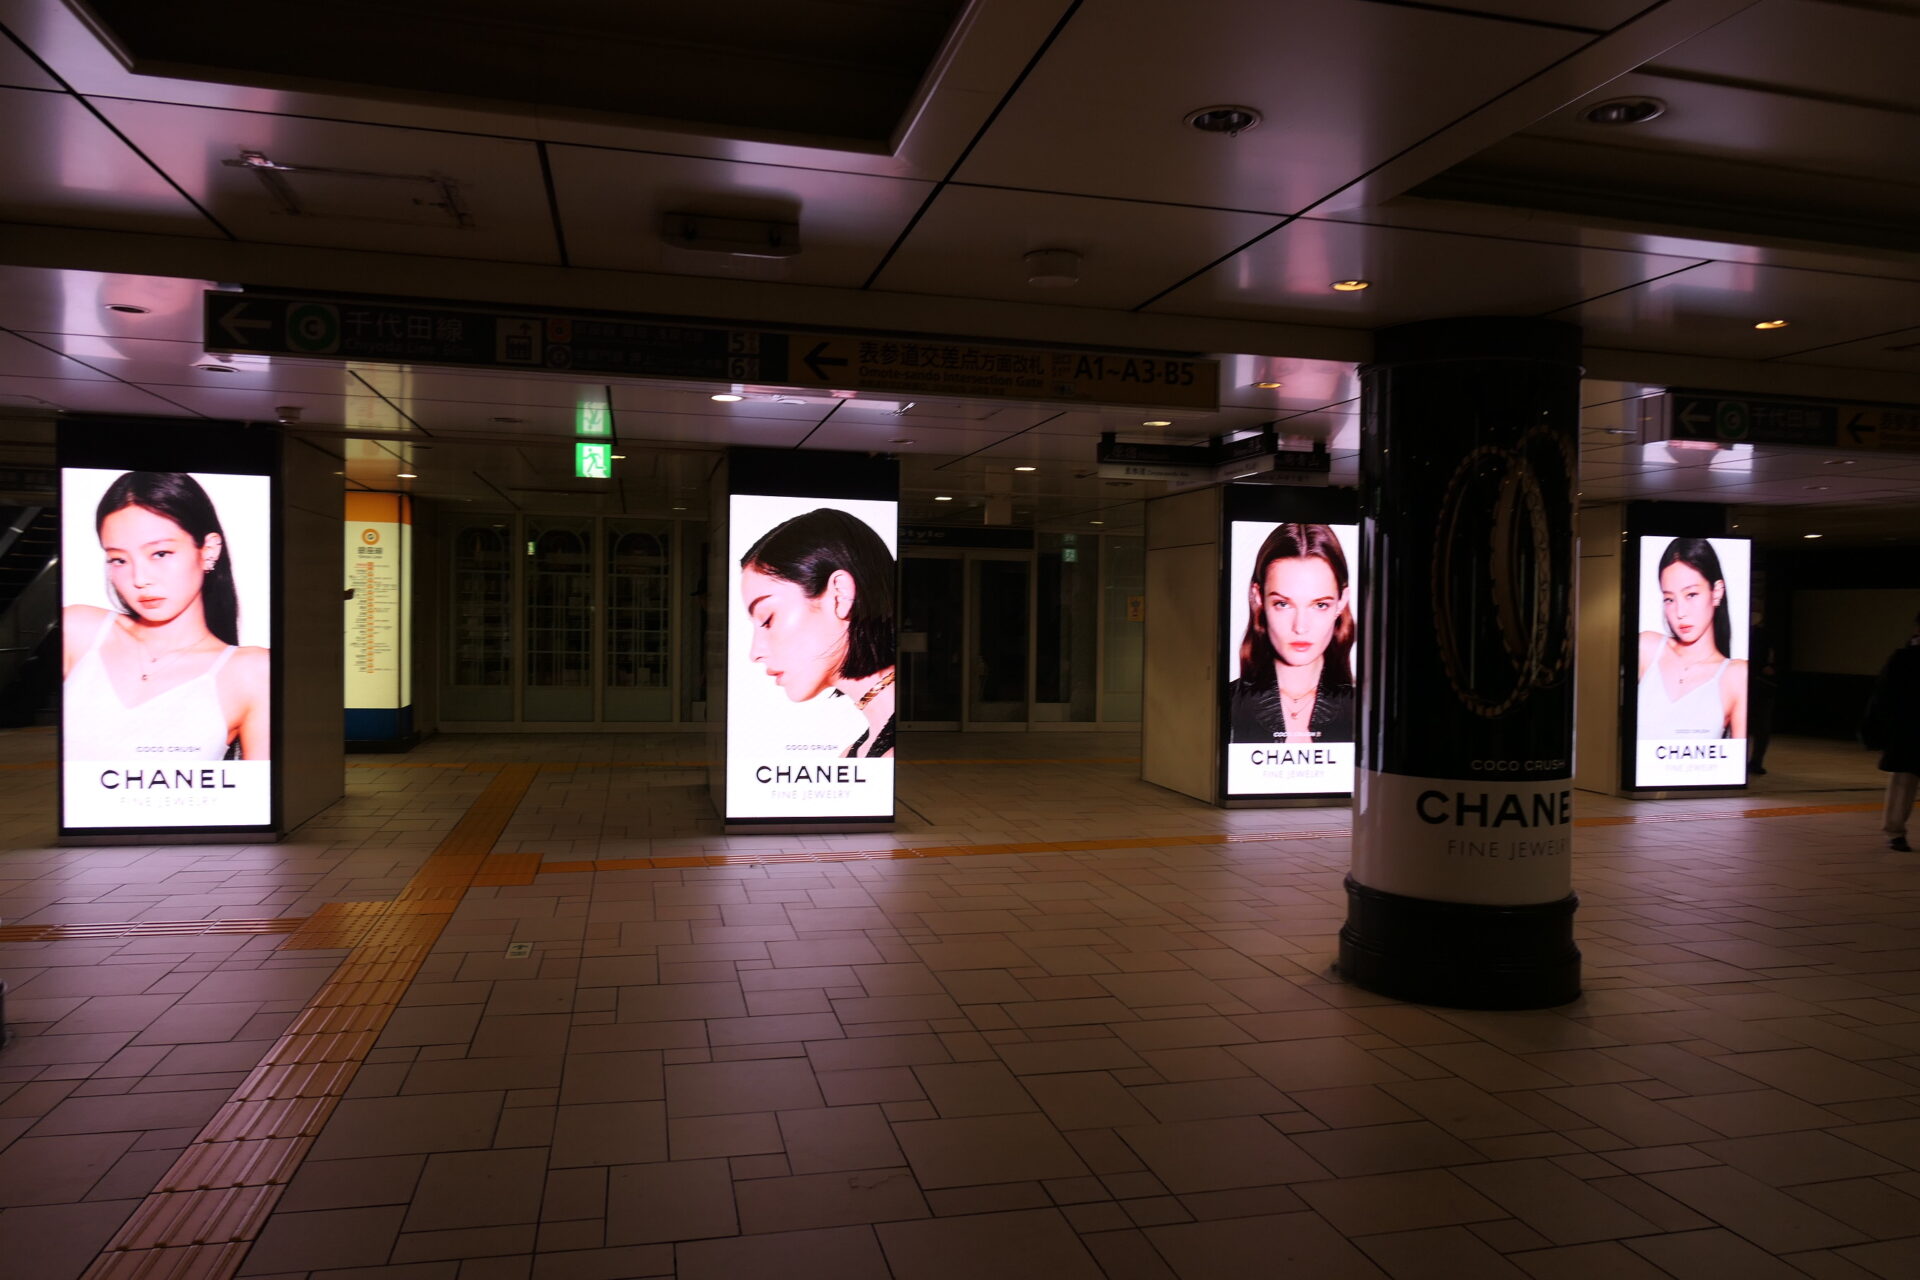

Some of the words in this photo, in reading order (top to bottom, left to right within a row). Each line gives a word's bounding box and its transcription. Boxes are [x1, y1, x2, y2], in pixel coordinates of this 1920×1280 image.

[344, 311, 464, 342] 千代田線
[730, 333, 745, 353] 5
[730, 358, 745, 378] 6
[858, 342, 1044, 375] 表参道交差点方面改札
[135, 745, 165, 753] COCO
[1250, 749, 1337, 766] CHANEL
[1655, 745, 1729, 760] CHANEL
[755, 765, 867, 784] CHANEL
[1471, 759, 1520, 772] COCO
[1524, 759, 1567, 771] CRUSH
[100, 768, 237, 790] CHANEL
[771, 789, 798, 800] FINE
[1447, 839, 1499, 859] FINE
